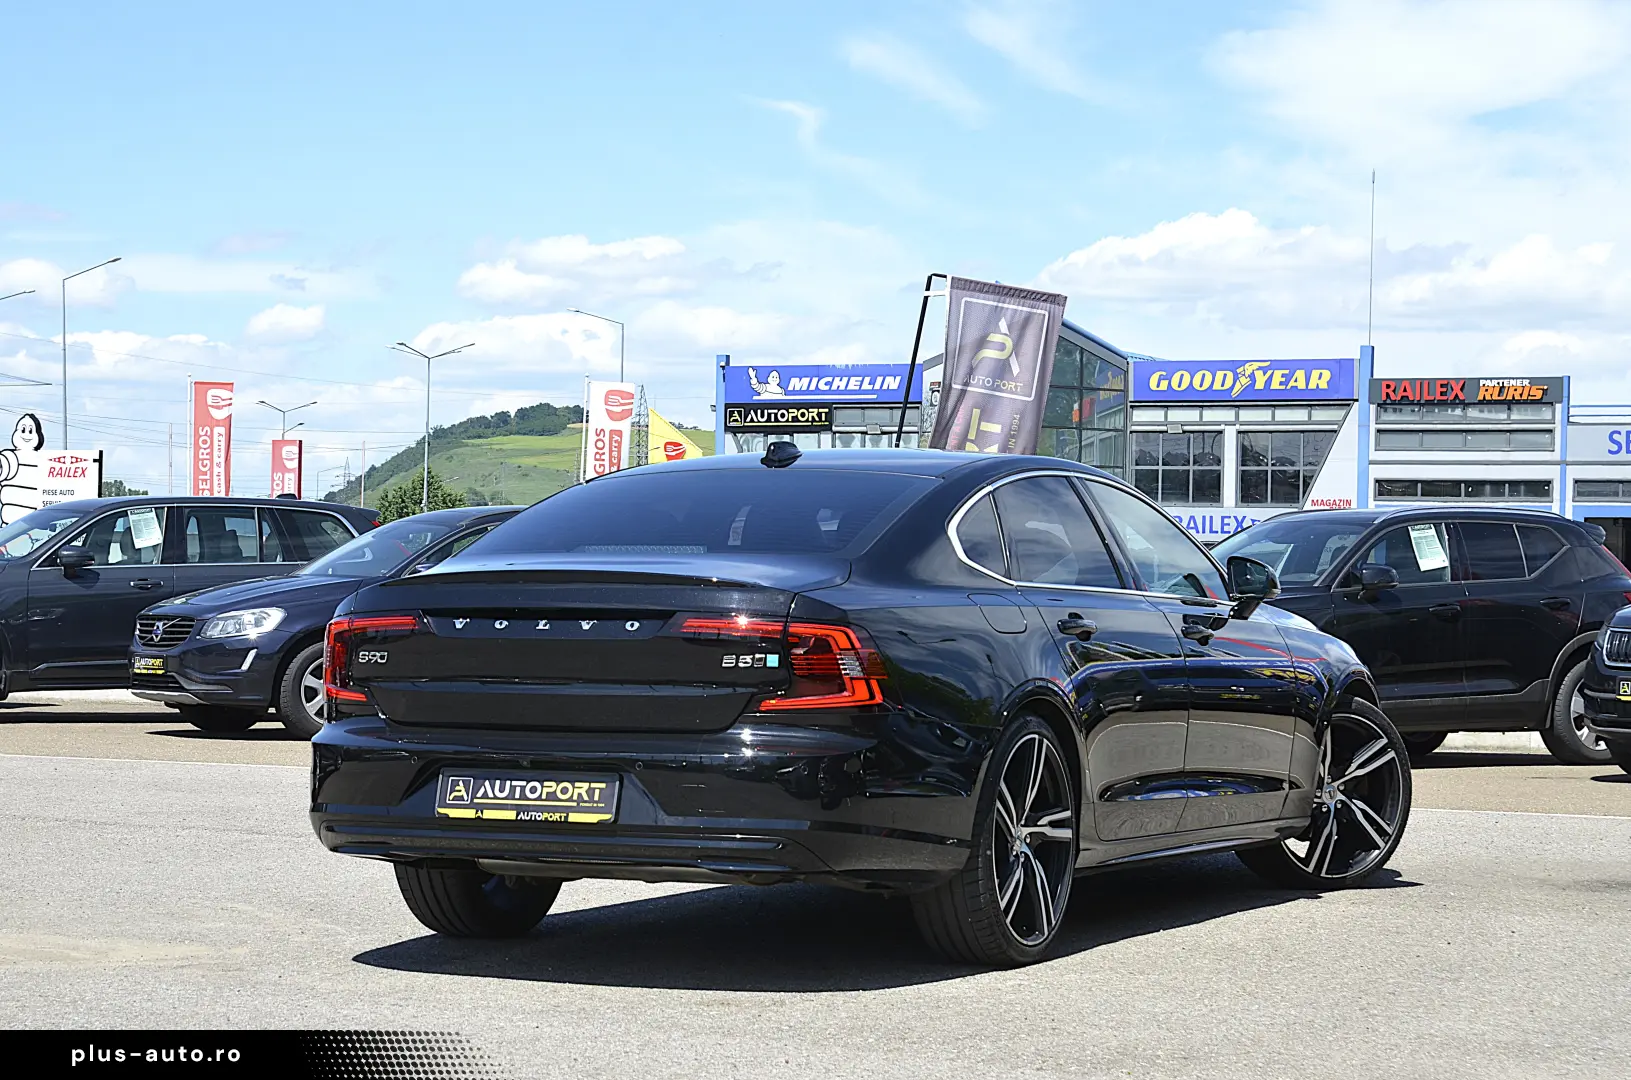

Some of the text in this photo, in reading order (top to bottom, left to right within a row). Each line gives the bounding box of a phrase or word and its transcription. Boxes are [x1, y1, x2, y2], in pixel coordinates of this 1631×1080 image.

[787, 376, 901, 391] MICHELIN
[963, 374, 1023, 391] AUTO PORT
[1381, 379, 1465, 401] RAILEX
[1479, 379, 1530, 387] PARTENER
[1477, 385, 1545, 401] RURIS
[745, 408, 829, 422] AUTOPORT
[1010, 414, 1020, 435] 1994
[594, 428, 606, 476] GROS
[612, 434, 620, 464] carry
[198, 426, 210, 496] SELGROS
[48, 466, 88, 478] RAILEX
[1310, 498, 1352, 507] MAGAZIN
[453, 618, 640, 631] VOLVO
[358, 652, 388, 664] S90
[476, 780, 607, 801] AUTOPORT
[517, 811, 566, 822] AUTOPORT
